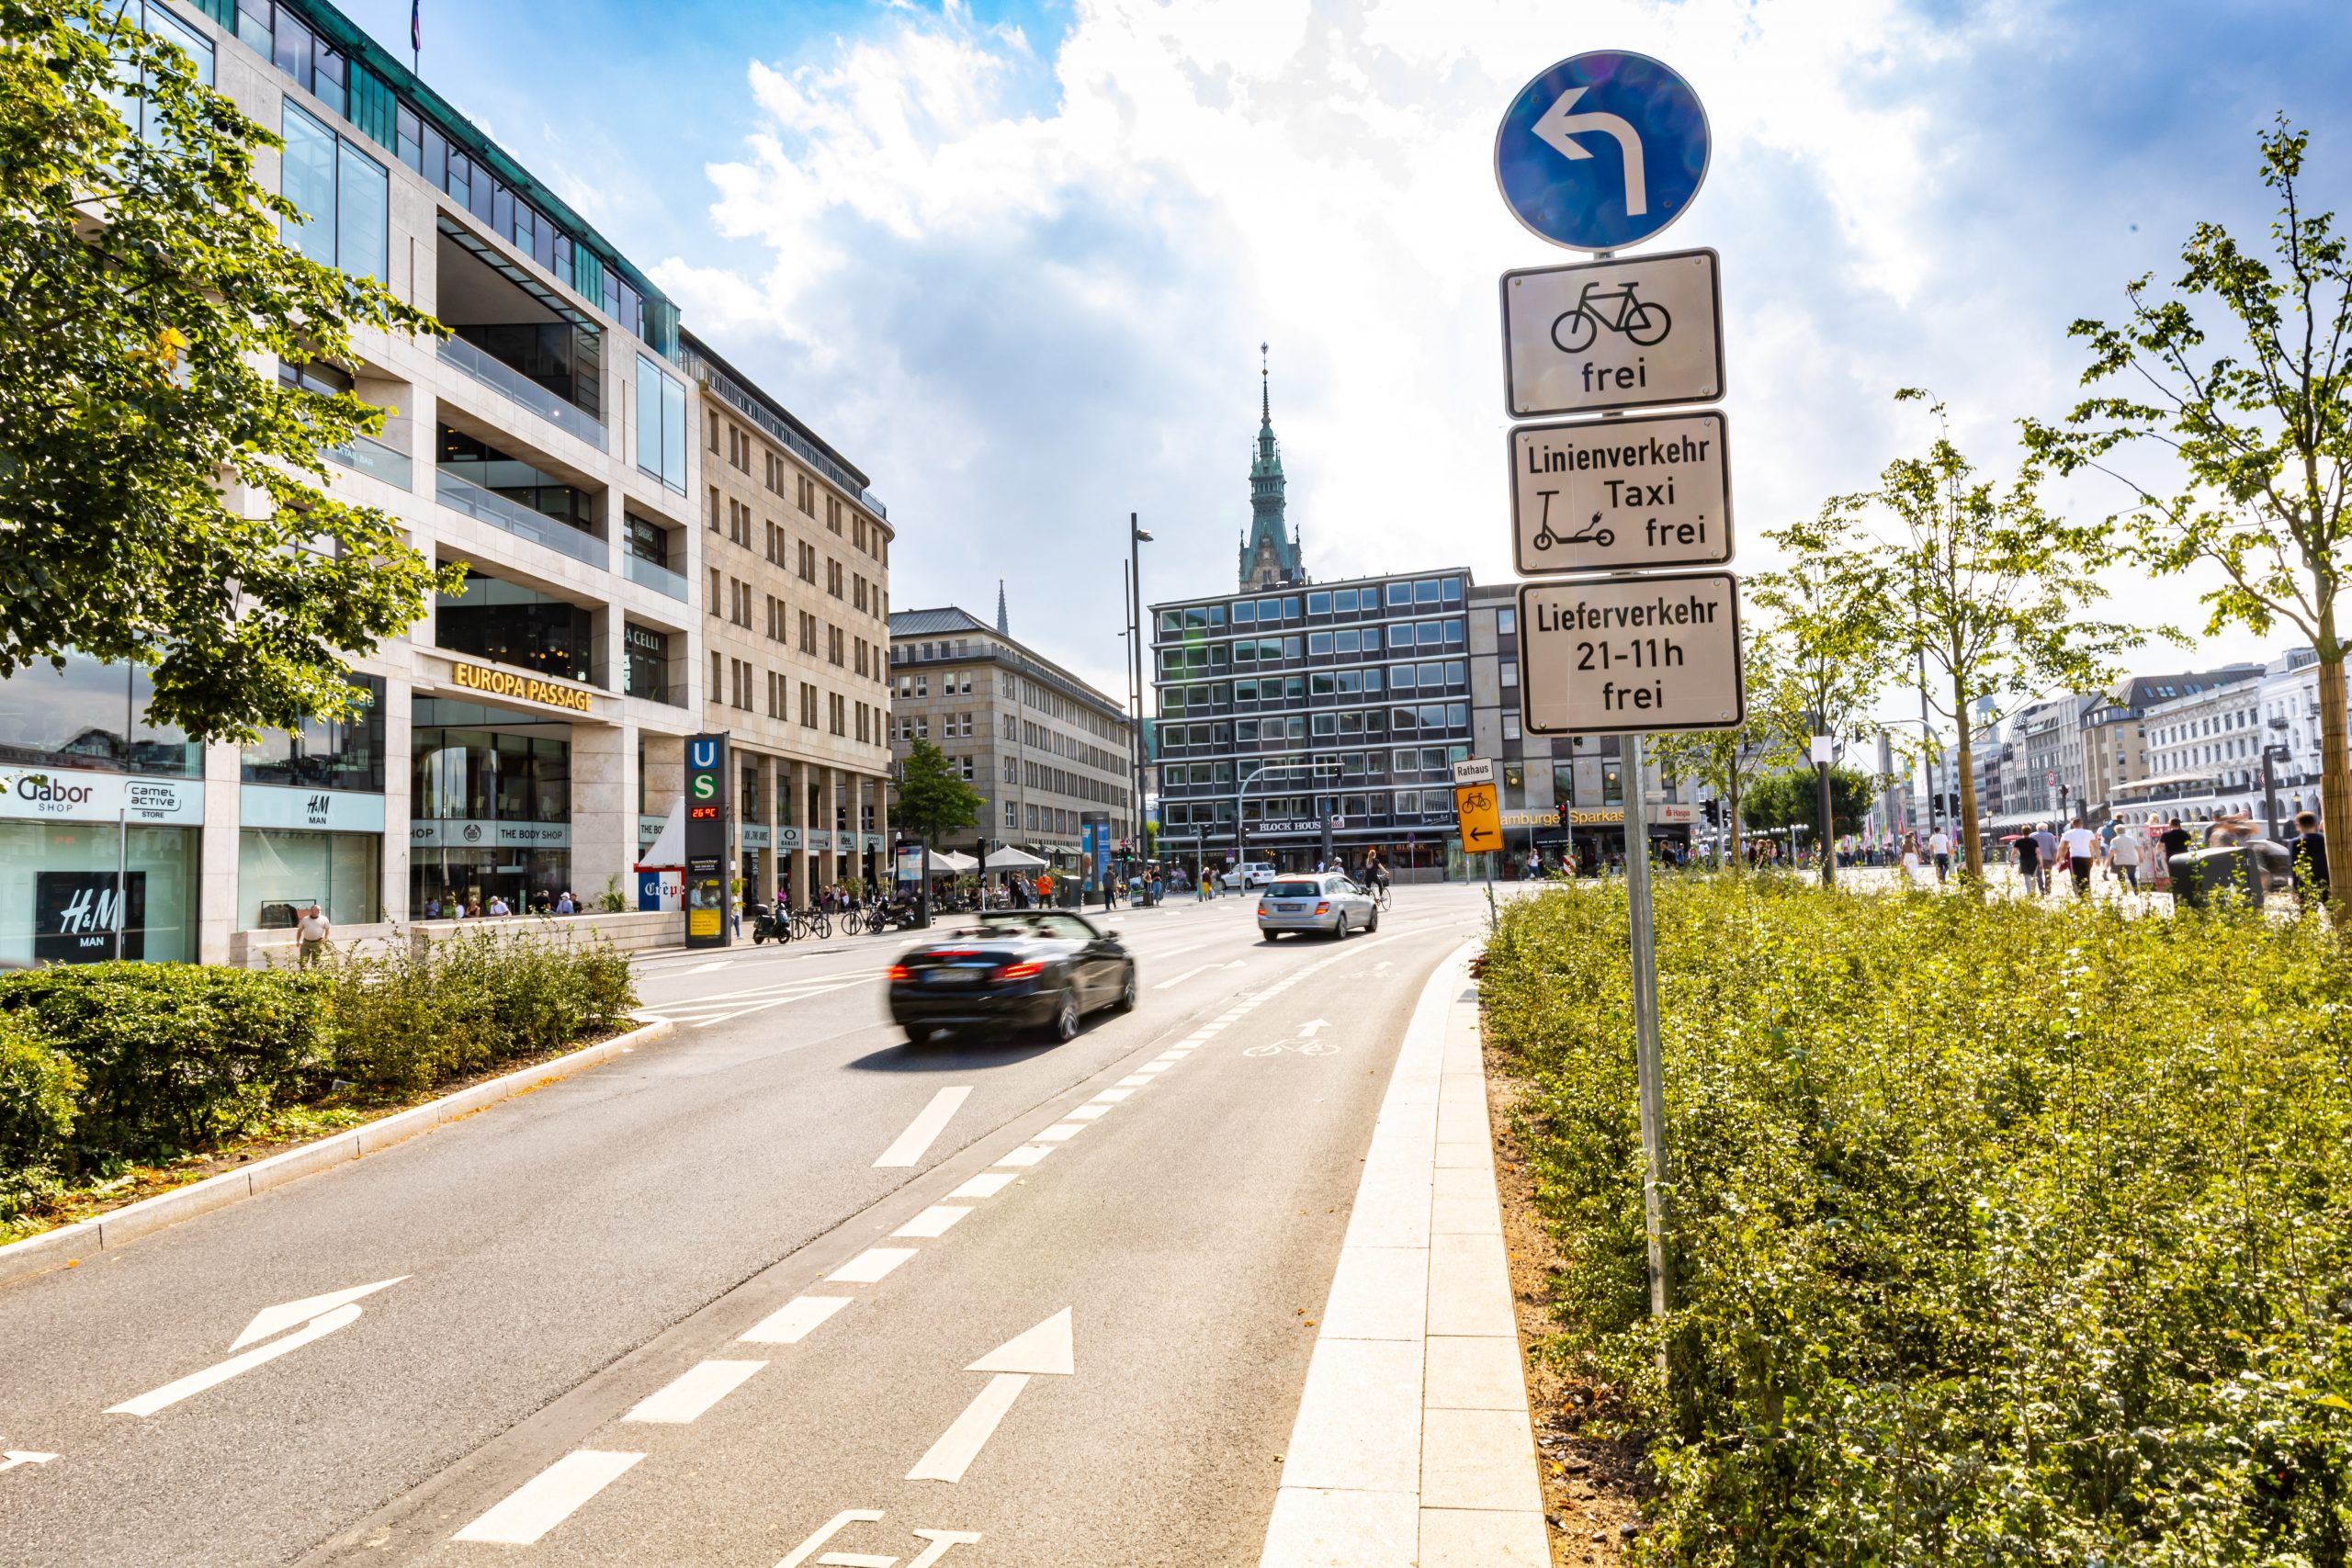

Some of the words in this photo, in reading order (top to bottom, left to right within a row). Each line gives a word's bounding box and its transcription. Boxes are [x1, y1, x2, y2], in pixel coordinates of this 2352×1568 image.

[1582, 357, 1646, 392] frei
[1529, 434, 1710, 474] Linienverkehr
[1604, 476, 1674, 509] Taxi
[1645, 514, 1706, 547] frei
[1537, 594, 1719, 633] Lieferverkehr
[624, 627, 632, 642] A
[634, 630, 659, 650] CELLI
[1577, 637, 1684, 671] 21-11h
[455, 662, 526, 698] EUROPA
[527, 680, 593, 712] PASSAGE
[1602, 679, 1664, 710] frei
[694, 741, 714, 767] U
[1457, 764, 1489, 776] Rathaus
[17, 777, 93, 803] Gabor
[695, 774, 714, 799] S
[39, 803, 73, 812] SHOP
[307, 795, 330, 815] H&M
[1673, 809, 1690, 818] Haspa
[309, 817, 327, 825] MAN
[641, 824, 652, 834] THE
[654, 825, 664, 835] BO
[1260, 823, 1292, 831] BLOCK
[1294, 821, 1321, 830] HOUS
[1500, 812, 1561, 826] amburge
[1569, 810, 1624, 824] Sparkas
[410, 829, 434, 839] HOP
[501, 829, 516, 839] THE
[519, 829, 540, 840] BODY
[542, 830, 563, 840] SHOP
[60, 888, 126, 934] H&M
[80, 937, 104, 947] MAN
